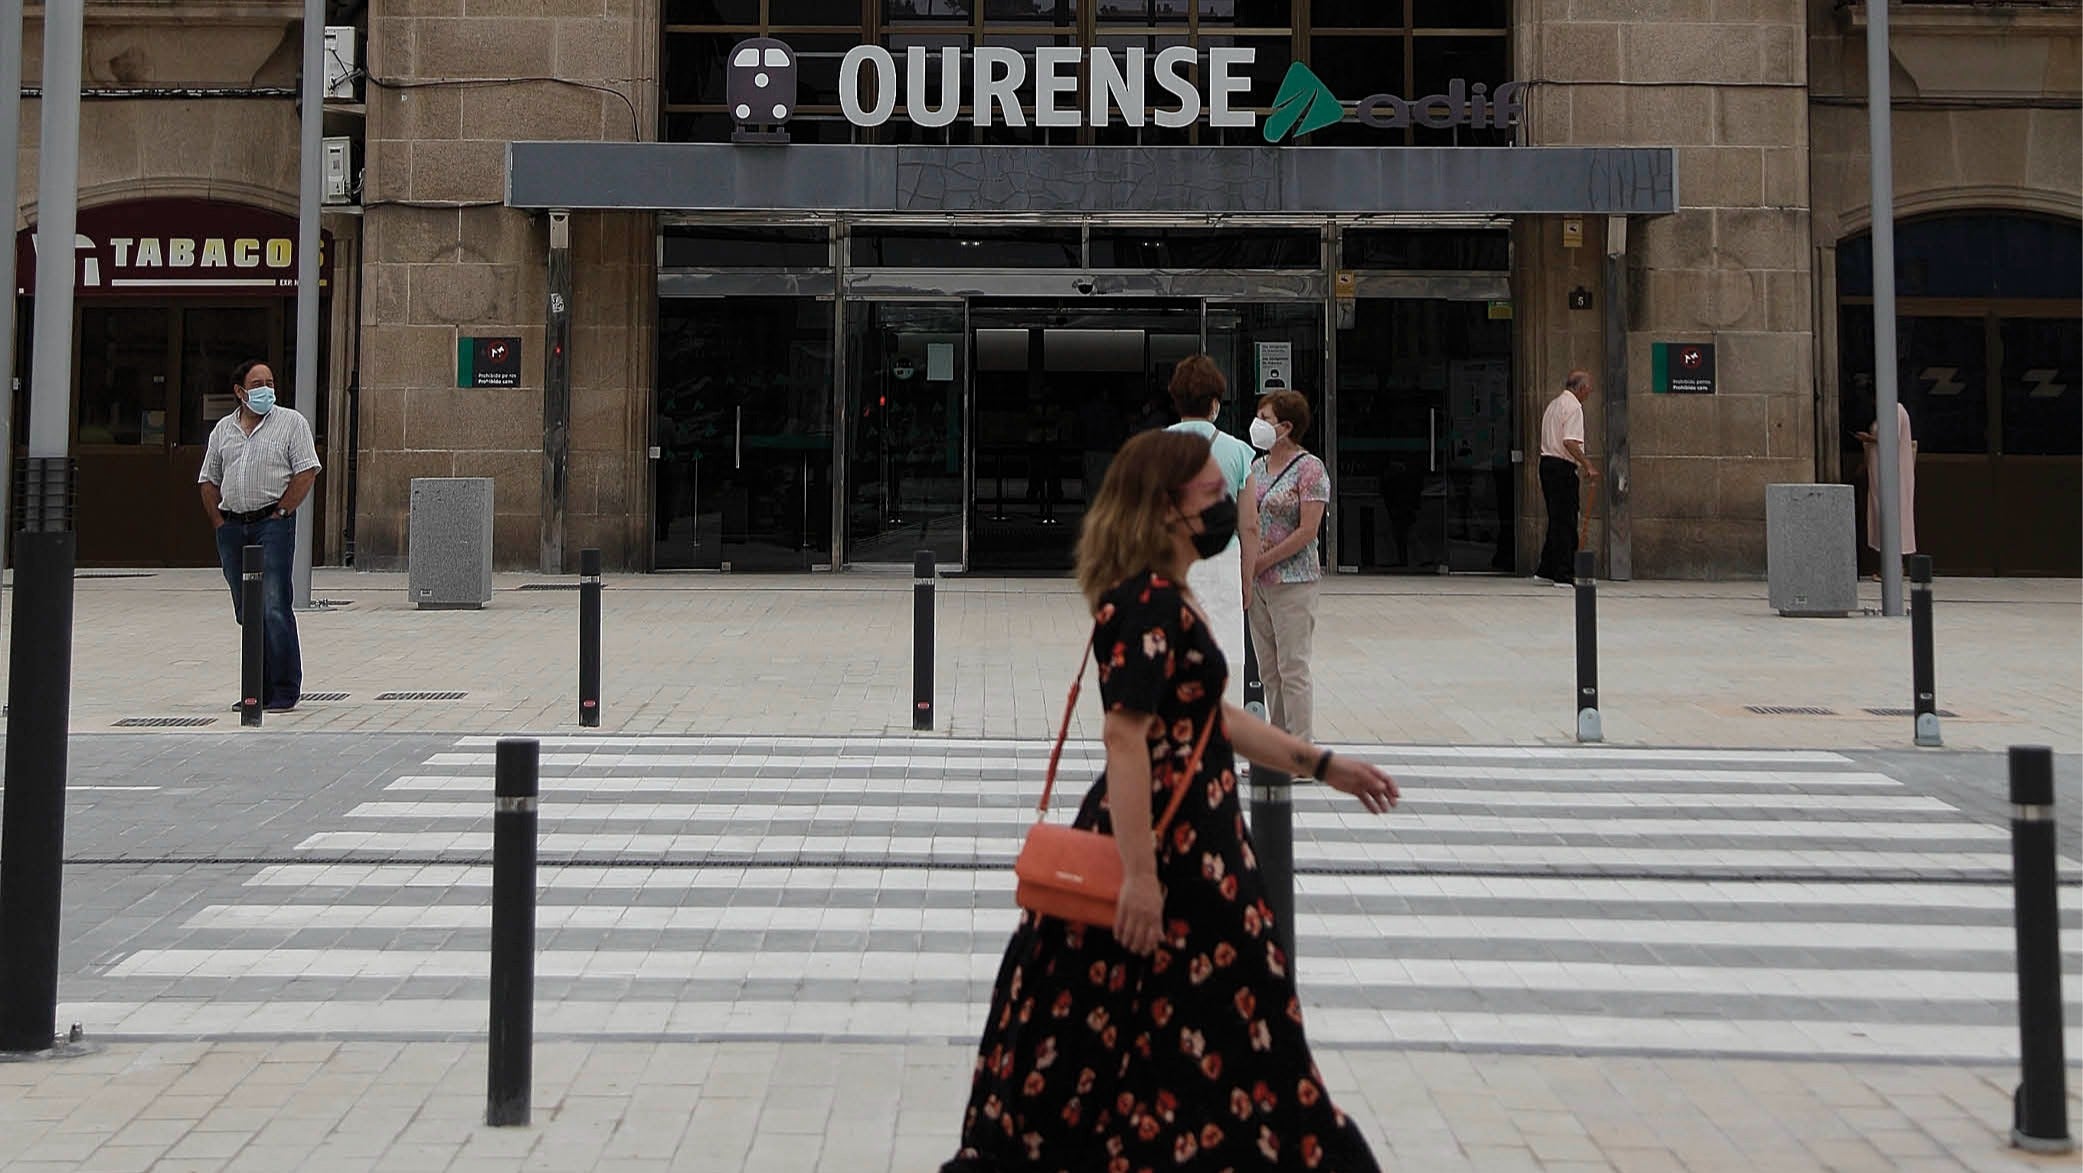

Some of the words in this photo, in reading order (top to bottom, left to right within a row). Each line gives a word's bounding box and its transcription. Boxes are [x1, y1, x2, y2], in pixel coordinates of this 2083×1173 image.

[838, 44, 1256, 128] OURENSE
[1357, 78, 1527, 129] adif
[110, 238, 325, 268] TABACO
[1577, 296, 1585, 306] 5
